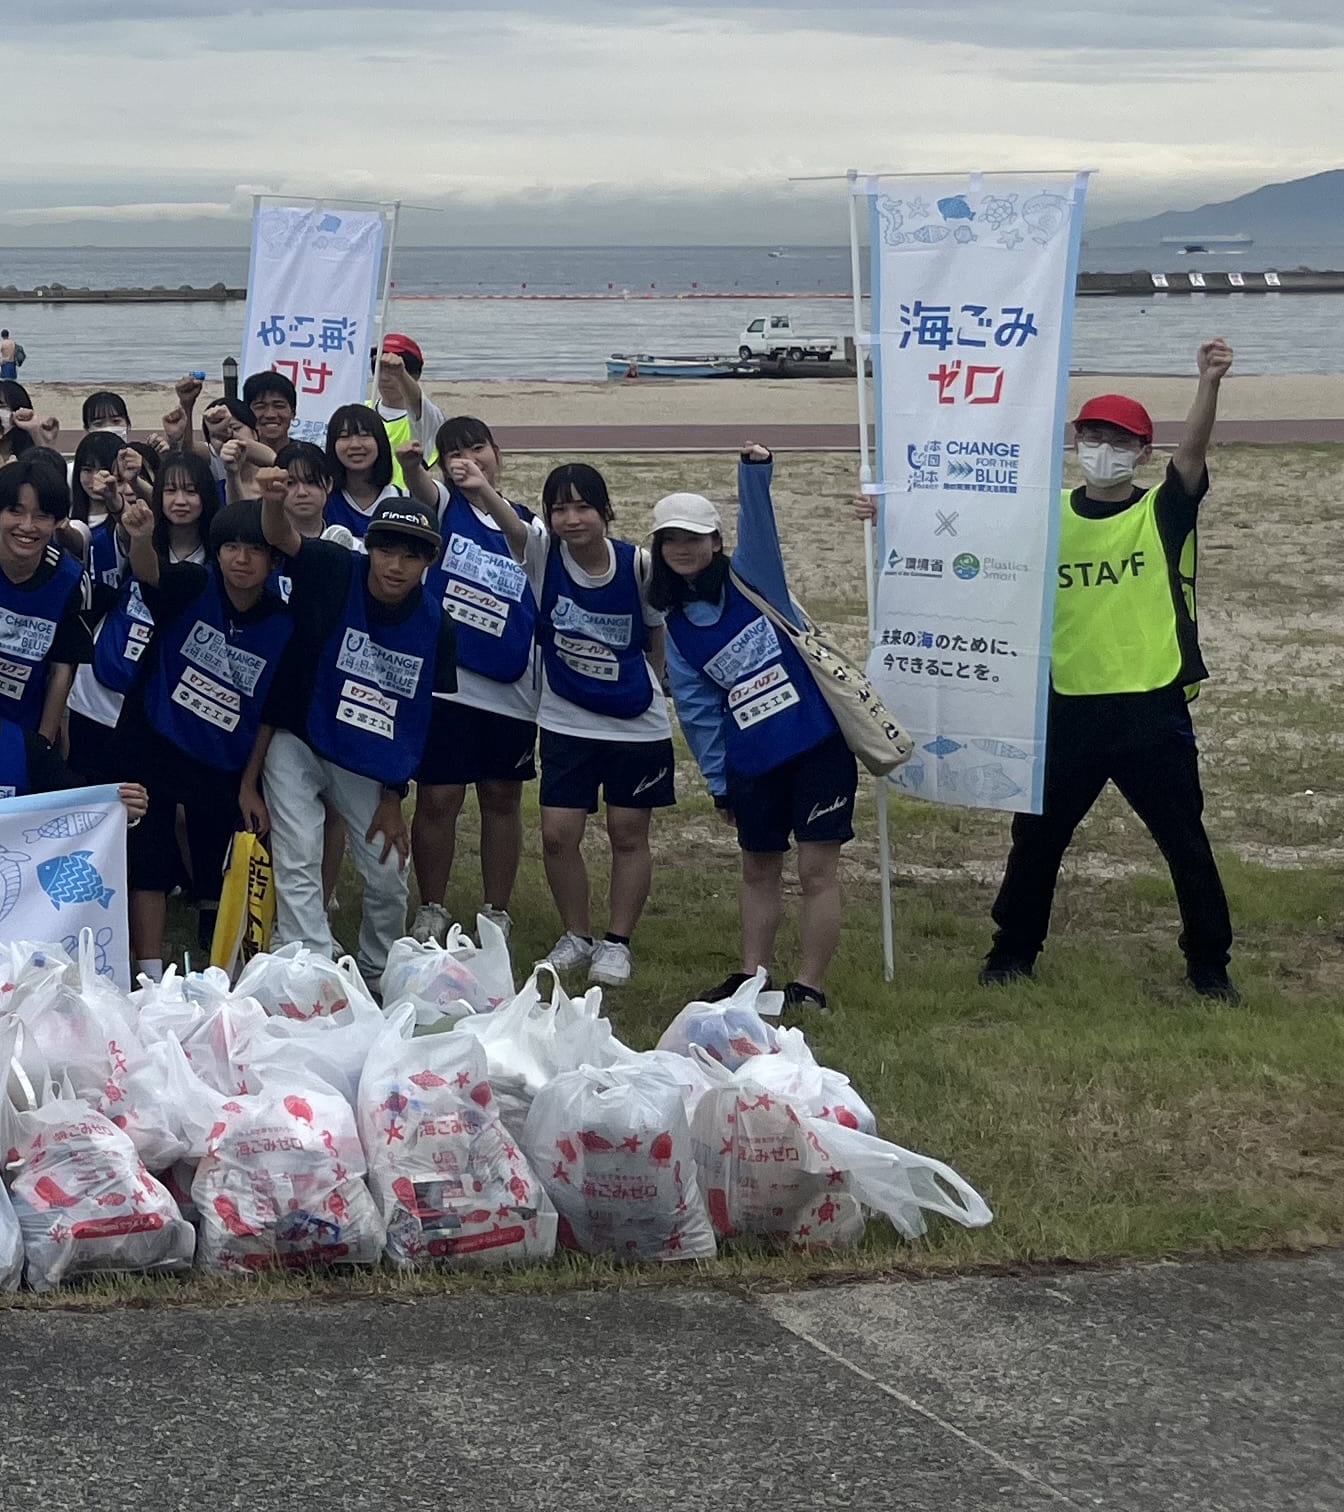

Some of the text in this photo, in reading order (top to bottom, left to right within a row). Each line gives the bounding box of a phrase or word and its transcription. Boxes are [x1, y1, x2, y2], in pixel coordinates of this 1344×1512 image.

[899, 300, 1038, 351] 海ごみ
[928, 359, 1005, 405] ゼロ
[946, 441, 1020, 457] CHANGE
[976, 458, 1019, 468] FOR THE
[975, 468, 1018, 485] BLUE
[983, 557, 1029, 572] Plastics
[4, 616, 53, 635] CHANGE
[580, 614, 631, 627] CHANGE
[21, 638, 49, 653] BLUE
[880, 629, 1018, 657] 未来の海のために、
[883, 653, 999, 683] 今できることを。
[385, 671, 416, 688] BLUE
